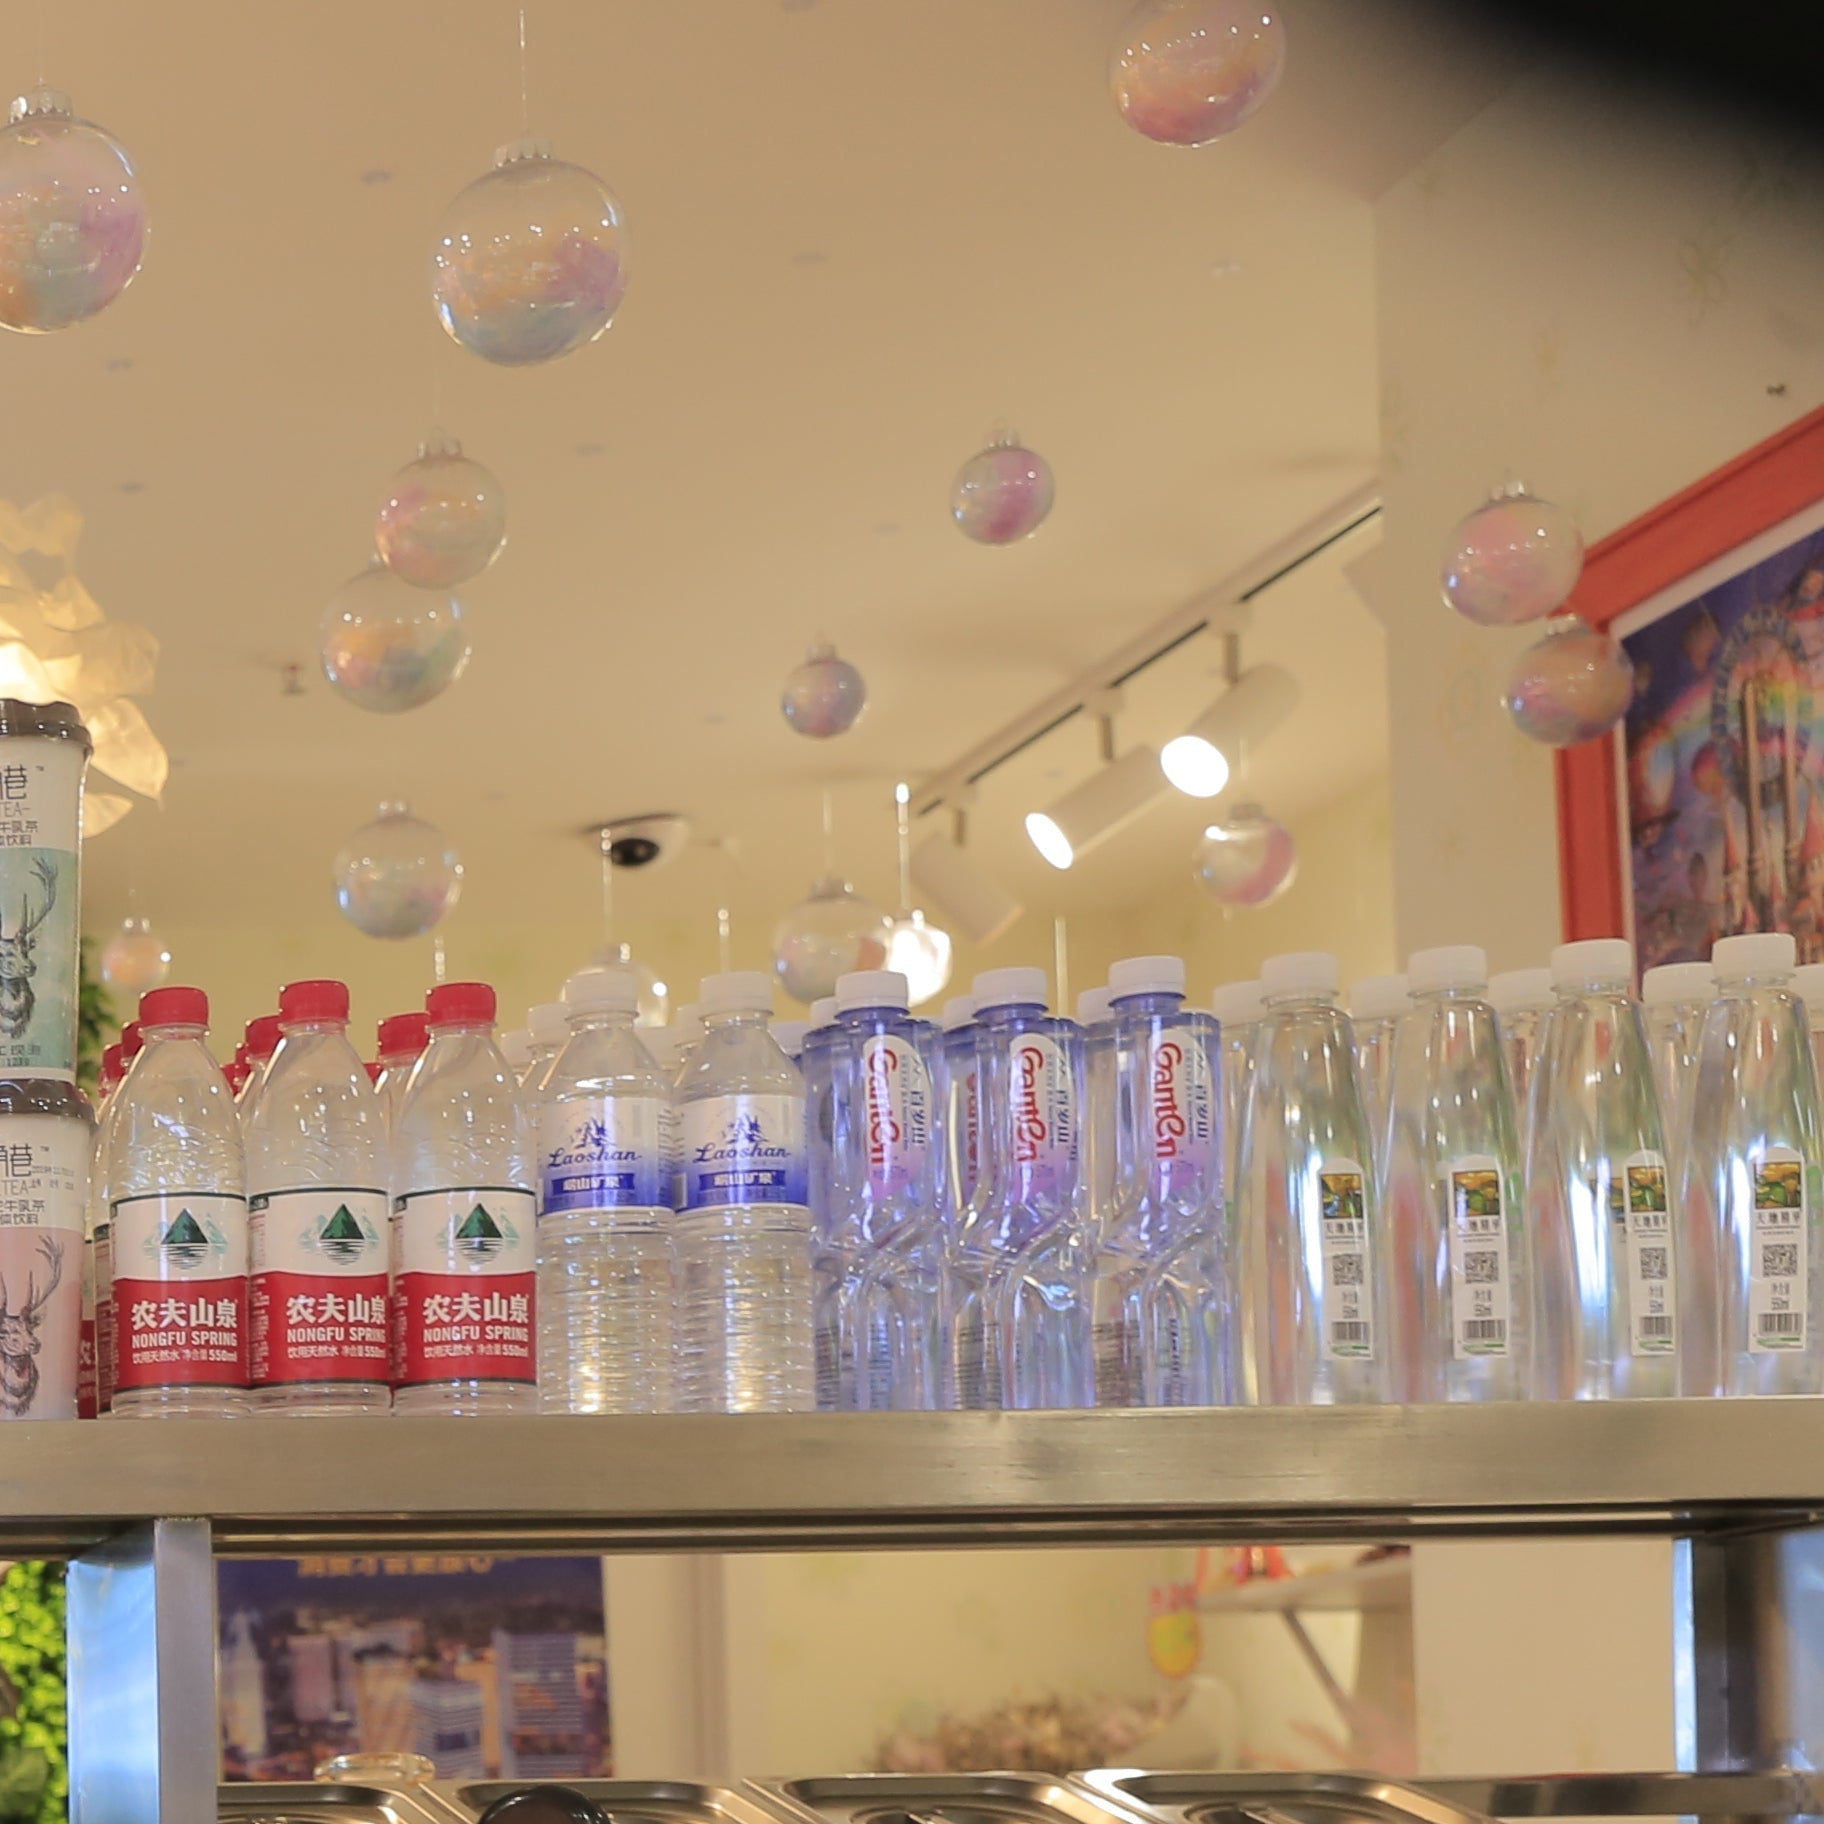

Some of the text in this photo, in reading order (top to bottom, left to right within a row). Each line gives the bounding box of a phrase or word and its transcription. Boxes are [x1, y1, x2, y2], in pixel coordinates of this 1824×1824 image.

[547, 1147, 642, 1168] Laoshan
[693, 1144, 791, 1163] Laoshan
[131, 1298, 238, 1330] 农夫山泉
[423, 1293, 528, 1324] 农夫山泉
[132, 1331, 238, 1350] NONGFU SPRING
[287, 1326, 345, 1343] NONGFU
[423, 1326, 528, 1343] NONGFU SPRING
